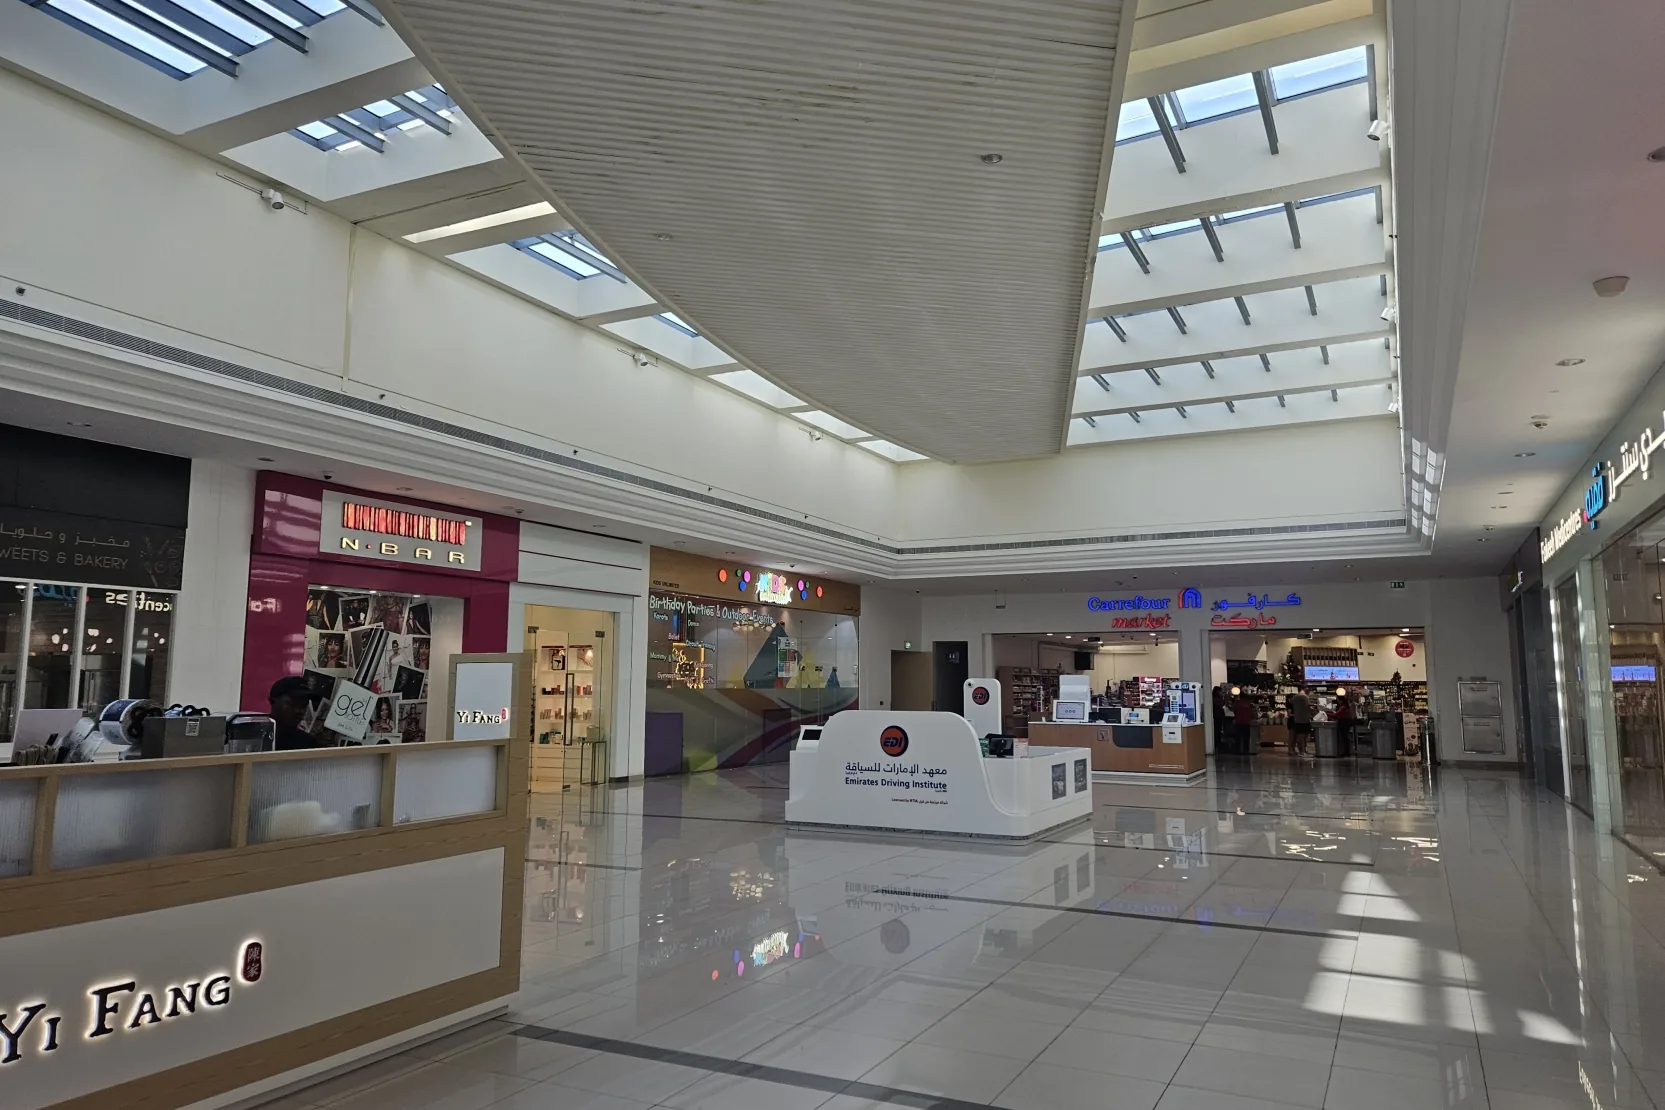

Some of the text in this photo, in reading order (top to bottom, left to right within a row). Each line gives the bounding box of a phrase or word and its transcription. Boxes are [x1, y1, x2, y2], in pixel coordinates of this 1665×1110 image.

[57, 552, 67, 564] &
[74, 554, 129, 570] BAKERY
[650, 595, 685, 613] Birthday
[687, 600, 714, 616] Parties
[722, 607, 749, 620] Outdoor
[752, 610, 774, 624] Events
[1087, 595, 1171, 611] Carrefour
[1211, 592, 1302, 611] كارفور
[1112, 613, 1171, 628] market
[1211, 613, 1276, 630] ماركت
[334, 694, 372, 721] gel
[883, 737, 904, 747] EDI
[845, 762, 947, 777] معهد الإمارات للسياقة
[845, 777, 947, 789] Emirates Driving Institute
